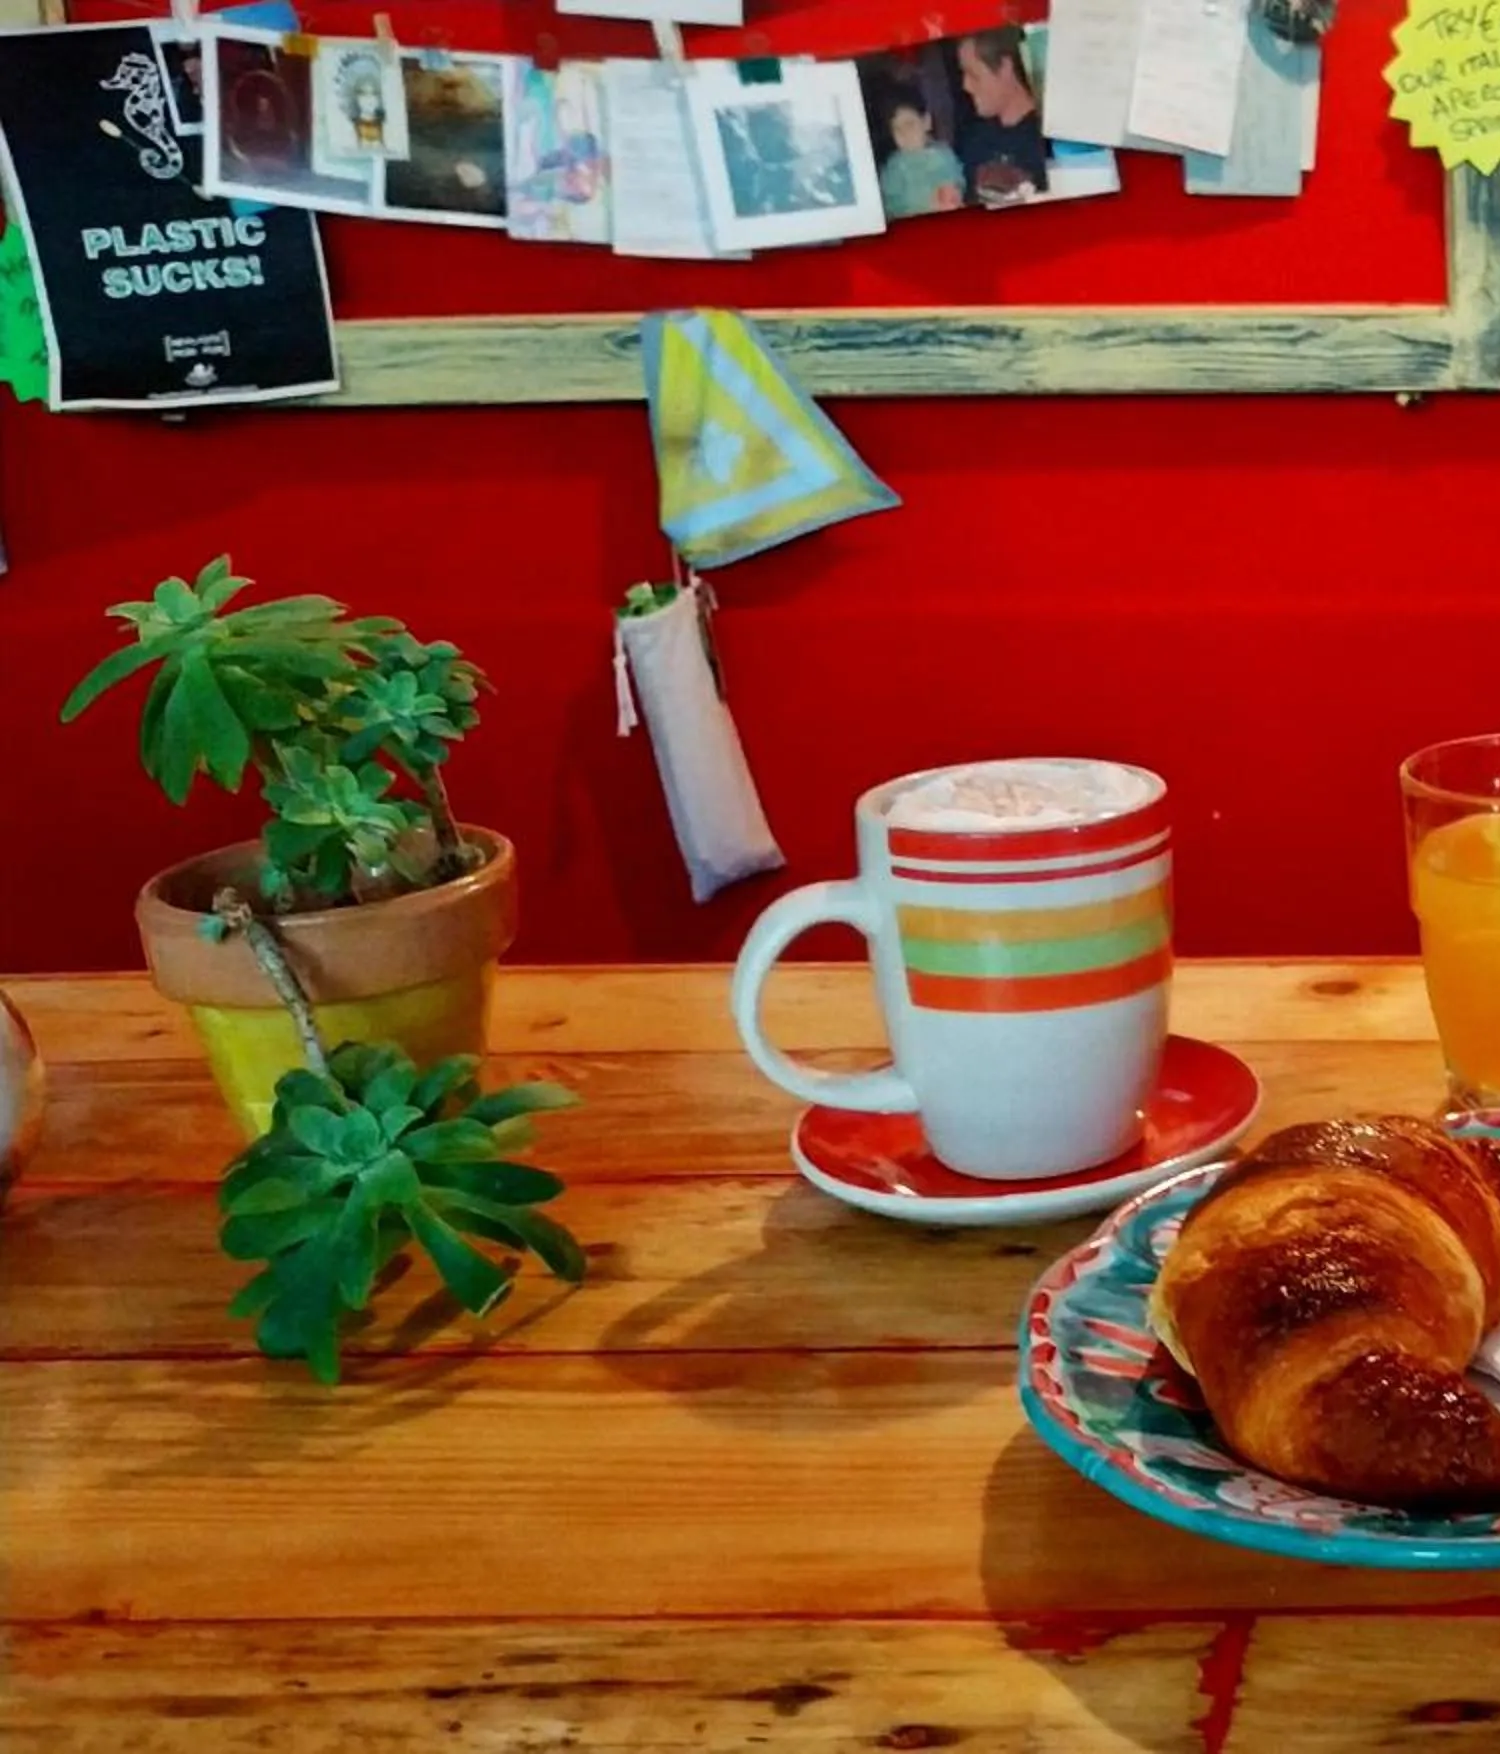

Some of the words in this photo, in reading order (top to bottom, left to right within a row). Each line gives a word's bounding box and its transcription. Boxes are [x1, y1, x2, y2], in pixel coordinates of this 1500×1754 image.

[1416, 5, 1477, 40] TRY
[1398, 59, 1449, 94] OUR
[80, 216, 267, 260] PLASTIC
[102, 255, 265, 299] SUCKS!
